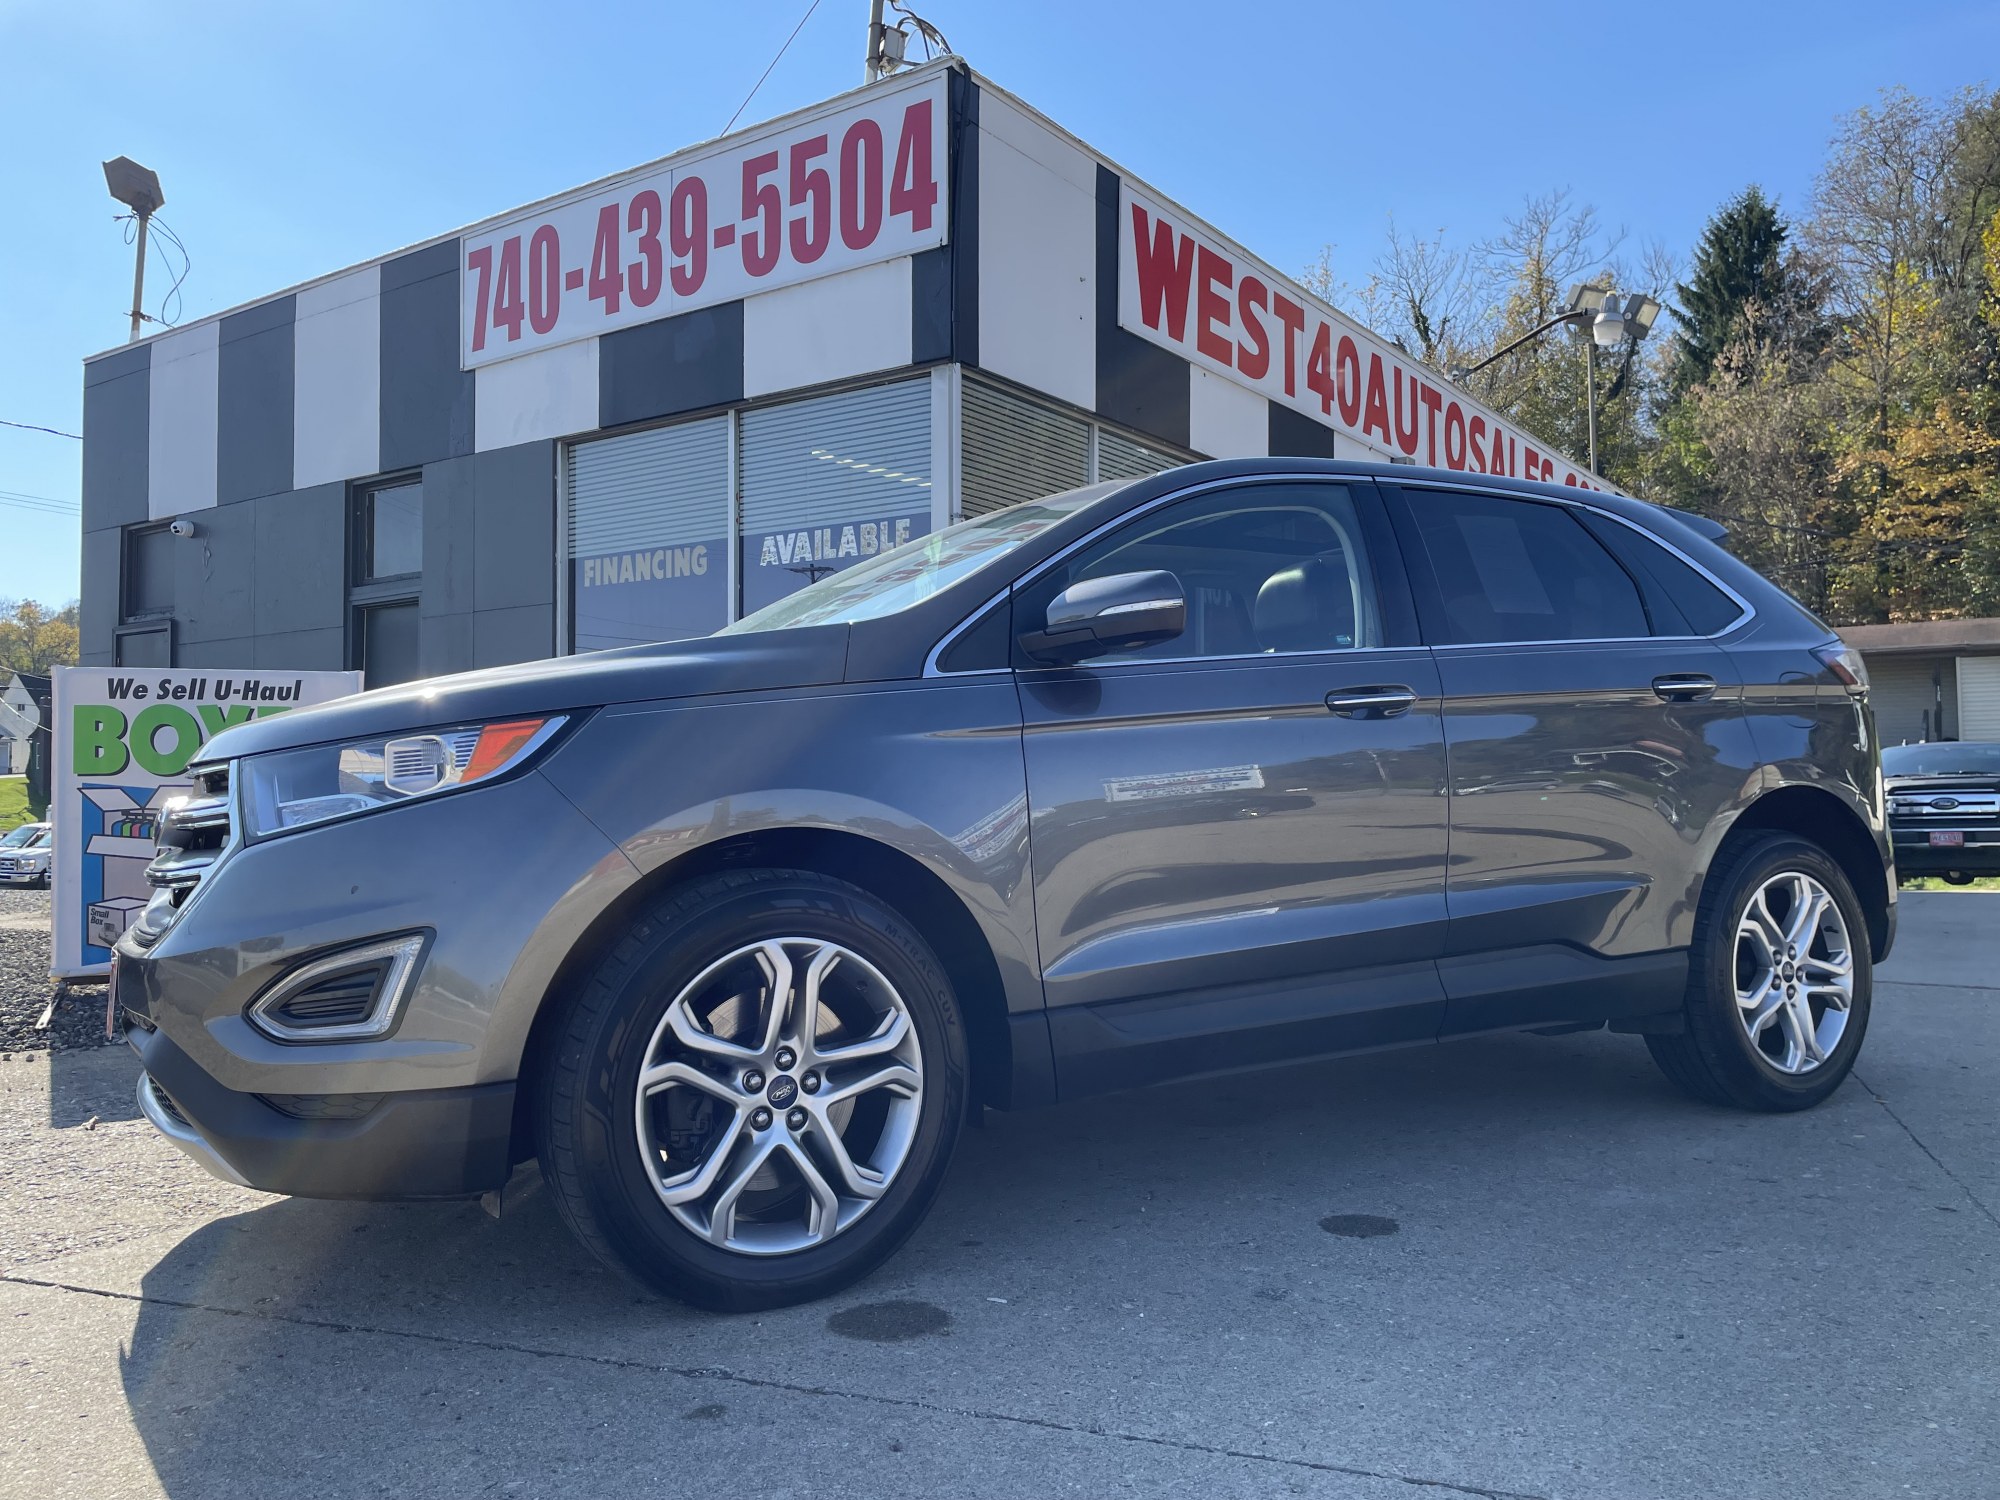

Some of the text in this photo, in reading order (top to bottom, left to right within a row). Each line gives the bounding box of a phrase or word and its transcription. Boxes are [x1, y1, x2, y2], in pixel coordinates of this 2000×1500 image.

[468, 99, 938, 352] 740-439-5504
[583, 545, 708, 588] FINANCING
[759, 518, 911, 567] AVAILABLE
[107, 678, 303, 701] We Sell U-Haul
[90, 908, 110, 919] Small
[90, 916, 104, 926] Box
[884, 923, 956, 1026] M-TRAC CUV
